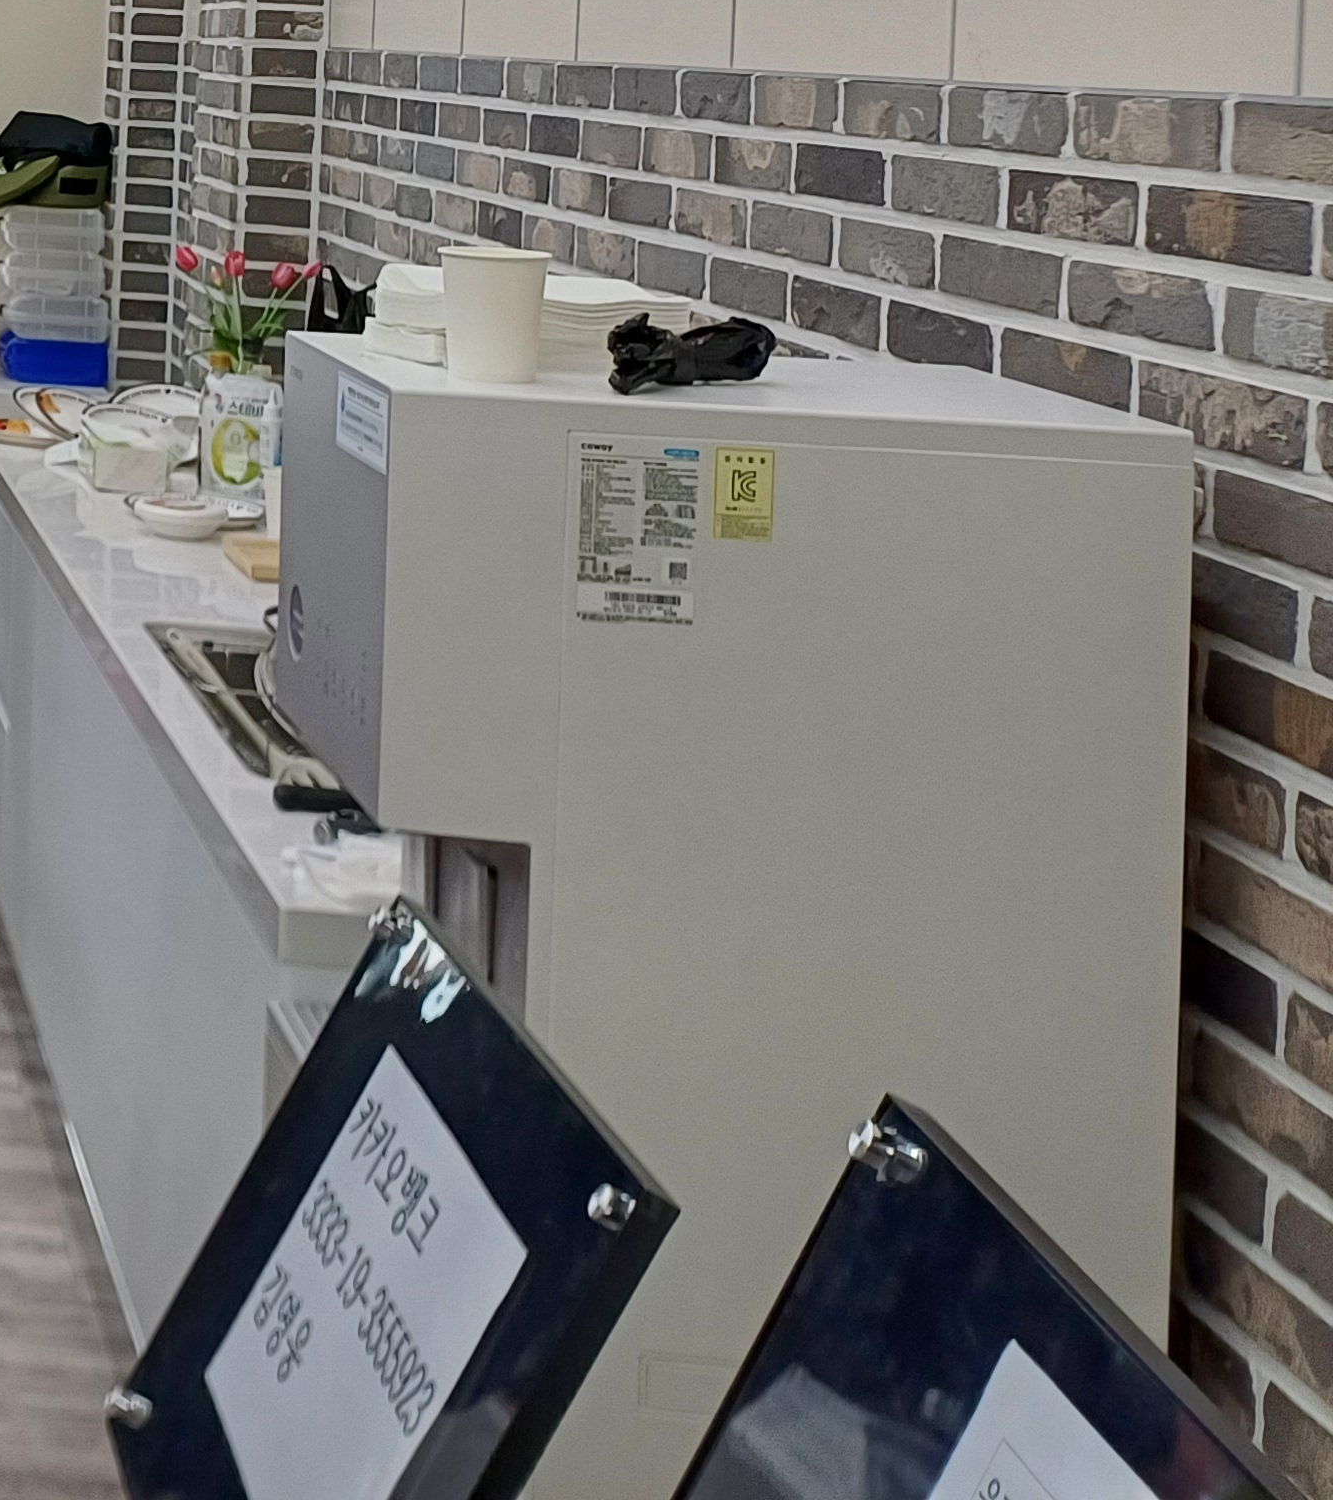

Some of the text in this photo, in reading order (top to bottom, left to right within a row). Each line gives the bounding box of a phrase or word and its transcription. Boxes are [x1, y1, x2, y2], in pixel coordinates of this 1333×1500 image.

[227, 399, 265, 418] 스테비
[581, 442, 613, 452] coway
[348, 1097, 441, 1257] 카카오뱅크
